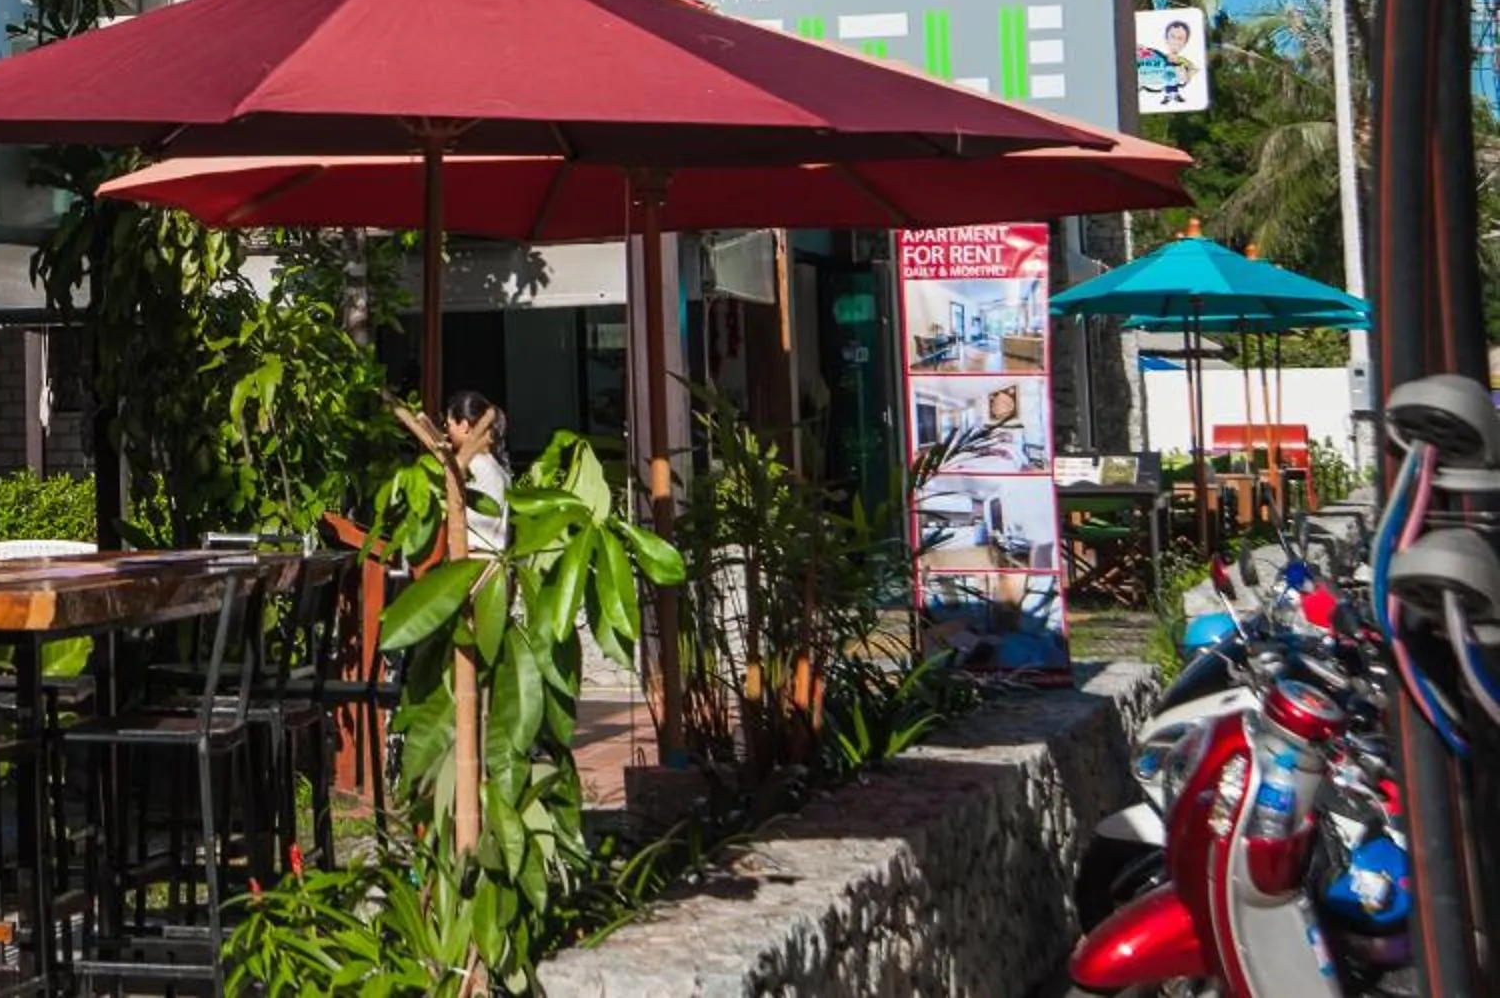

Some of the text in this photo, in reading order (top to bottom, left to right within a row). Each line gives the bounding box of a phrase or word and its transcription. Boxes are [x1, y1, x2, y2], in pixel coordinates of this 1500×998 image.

[904, 245, 1004, 265] FOR RENT
[904, 265, 936, 277] DAILY
